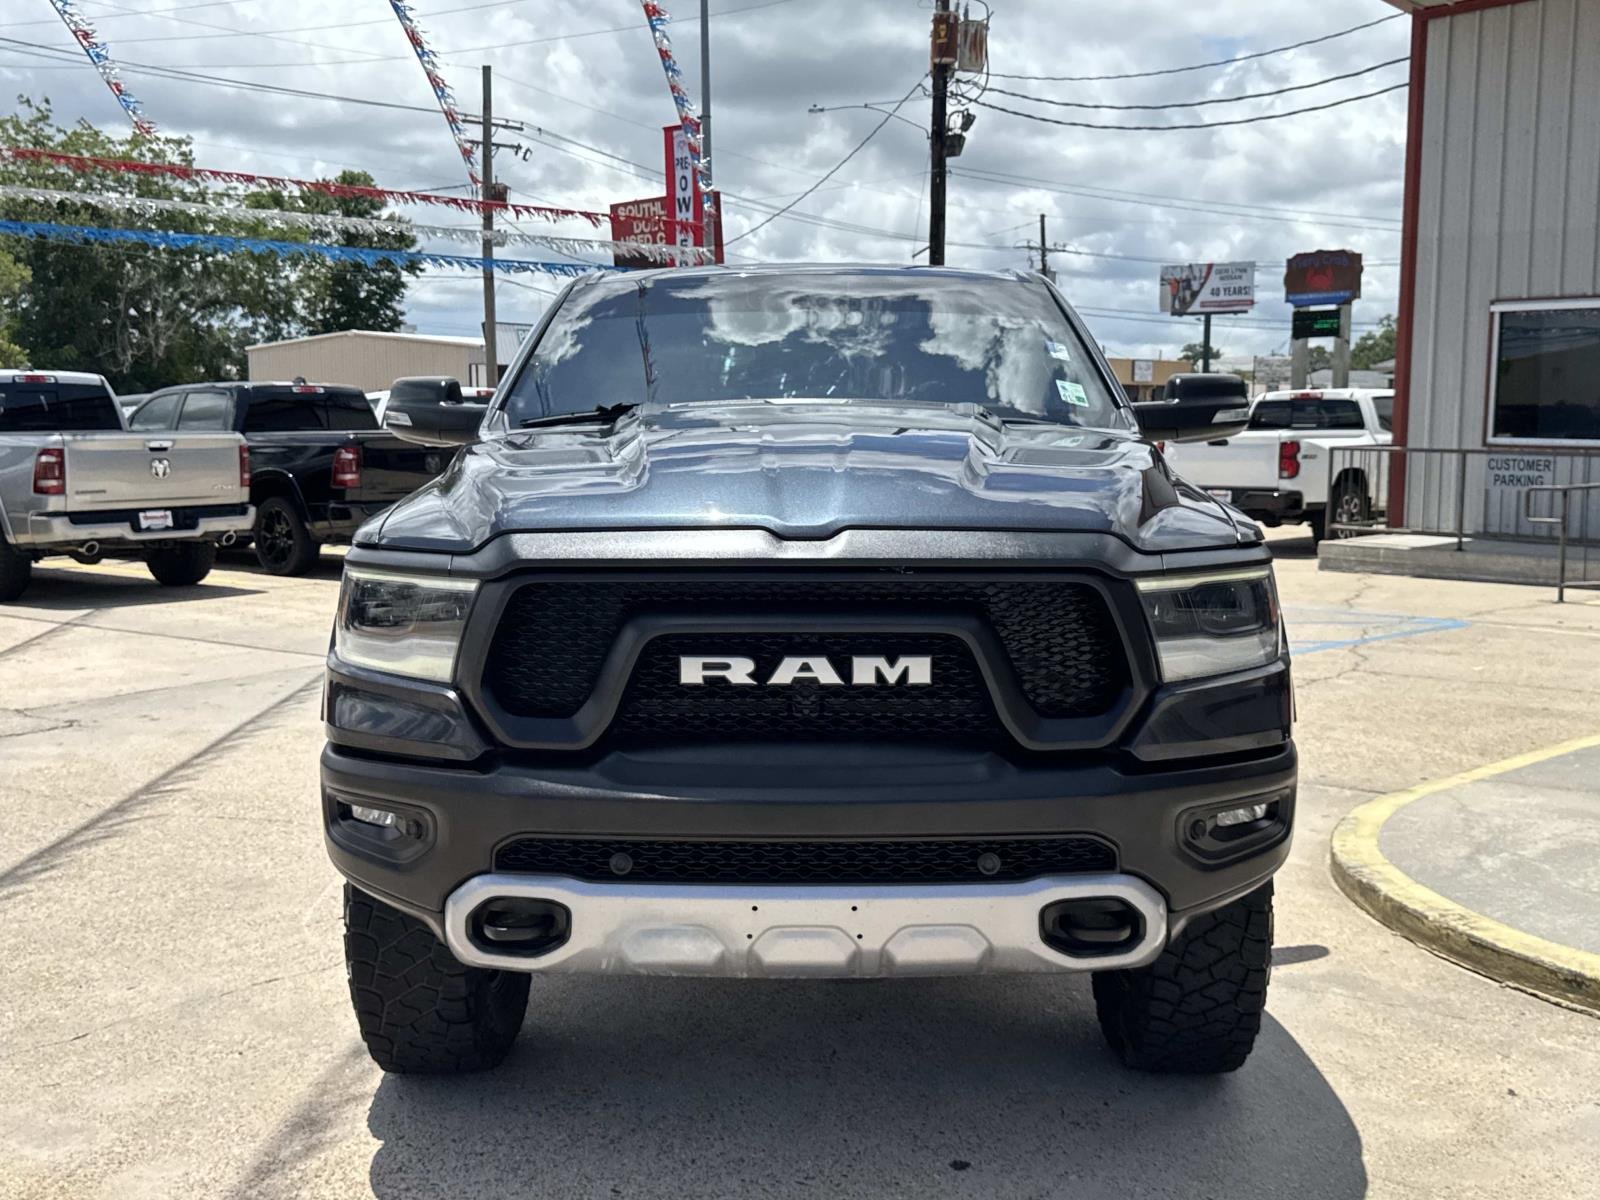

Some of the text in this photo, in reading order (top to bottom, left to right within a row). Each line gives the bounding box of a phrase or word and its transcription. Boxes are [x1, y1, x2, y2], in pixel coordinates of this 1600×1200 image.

[618, 202, 666, 220] SOUTHL
[1488, 458, 1552, 472] CUSTOMER
[1493, 474, 1544, 486] PARKING
[680, 655, 932, 684] RAM
